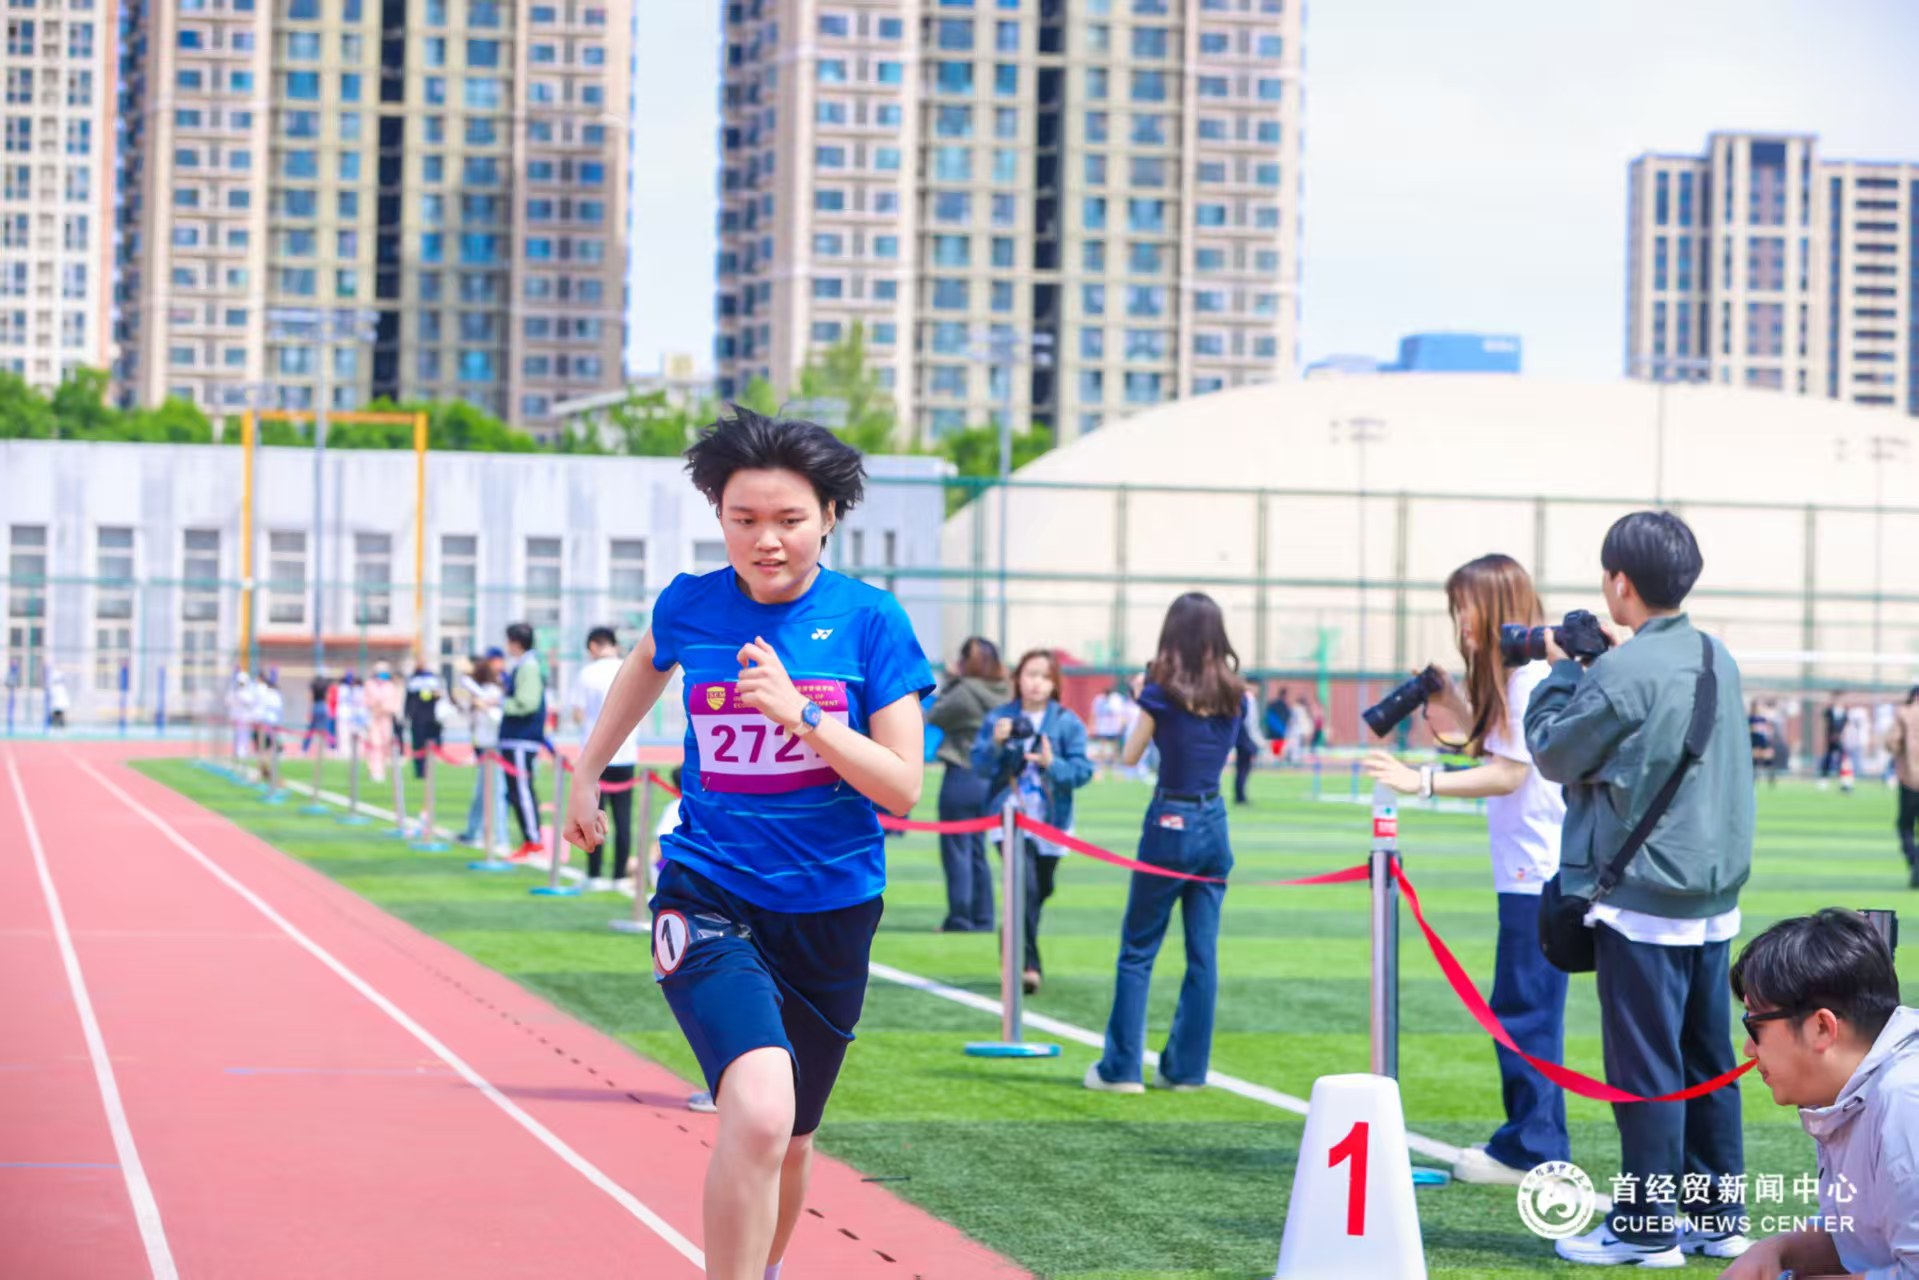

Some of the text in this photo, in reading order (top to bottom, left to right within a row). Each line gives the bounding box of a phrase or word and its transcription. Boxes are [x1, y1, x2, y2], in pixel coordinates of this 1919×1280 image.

[711, 724, 821, 763] 272
[661, 918, 675, 962] 1
[1328, 1121, 1369, 1236] 1
